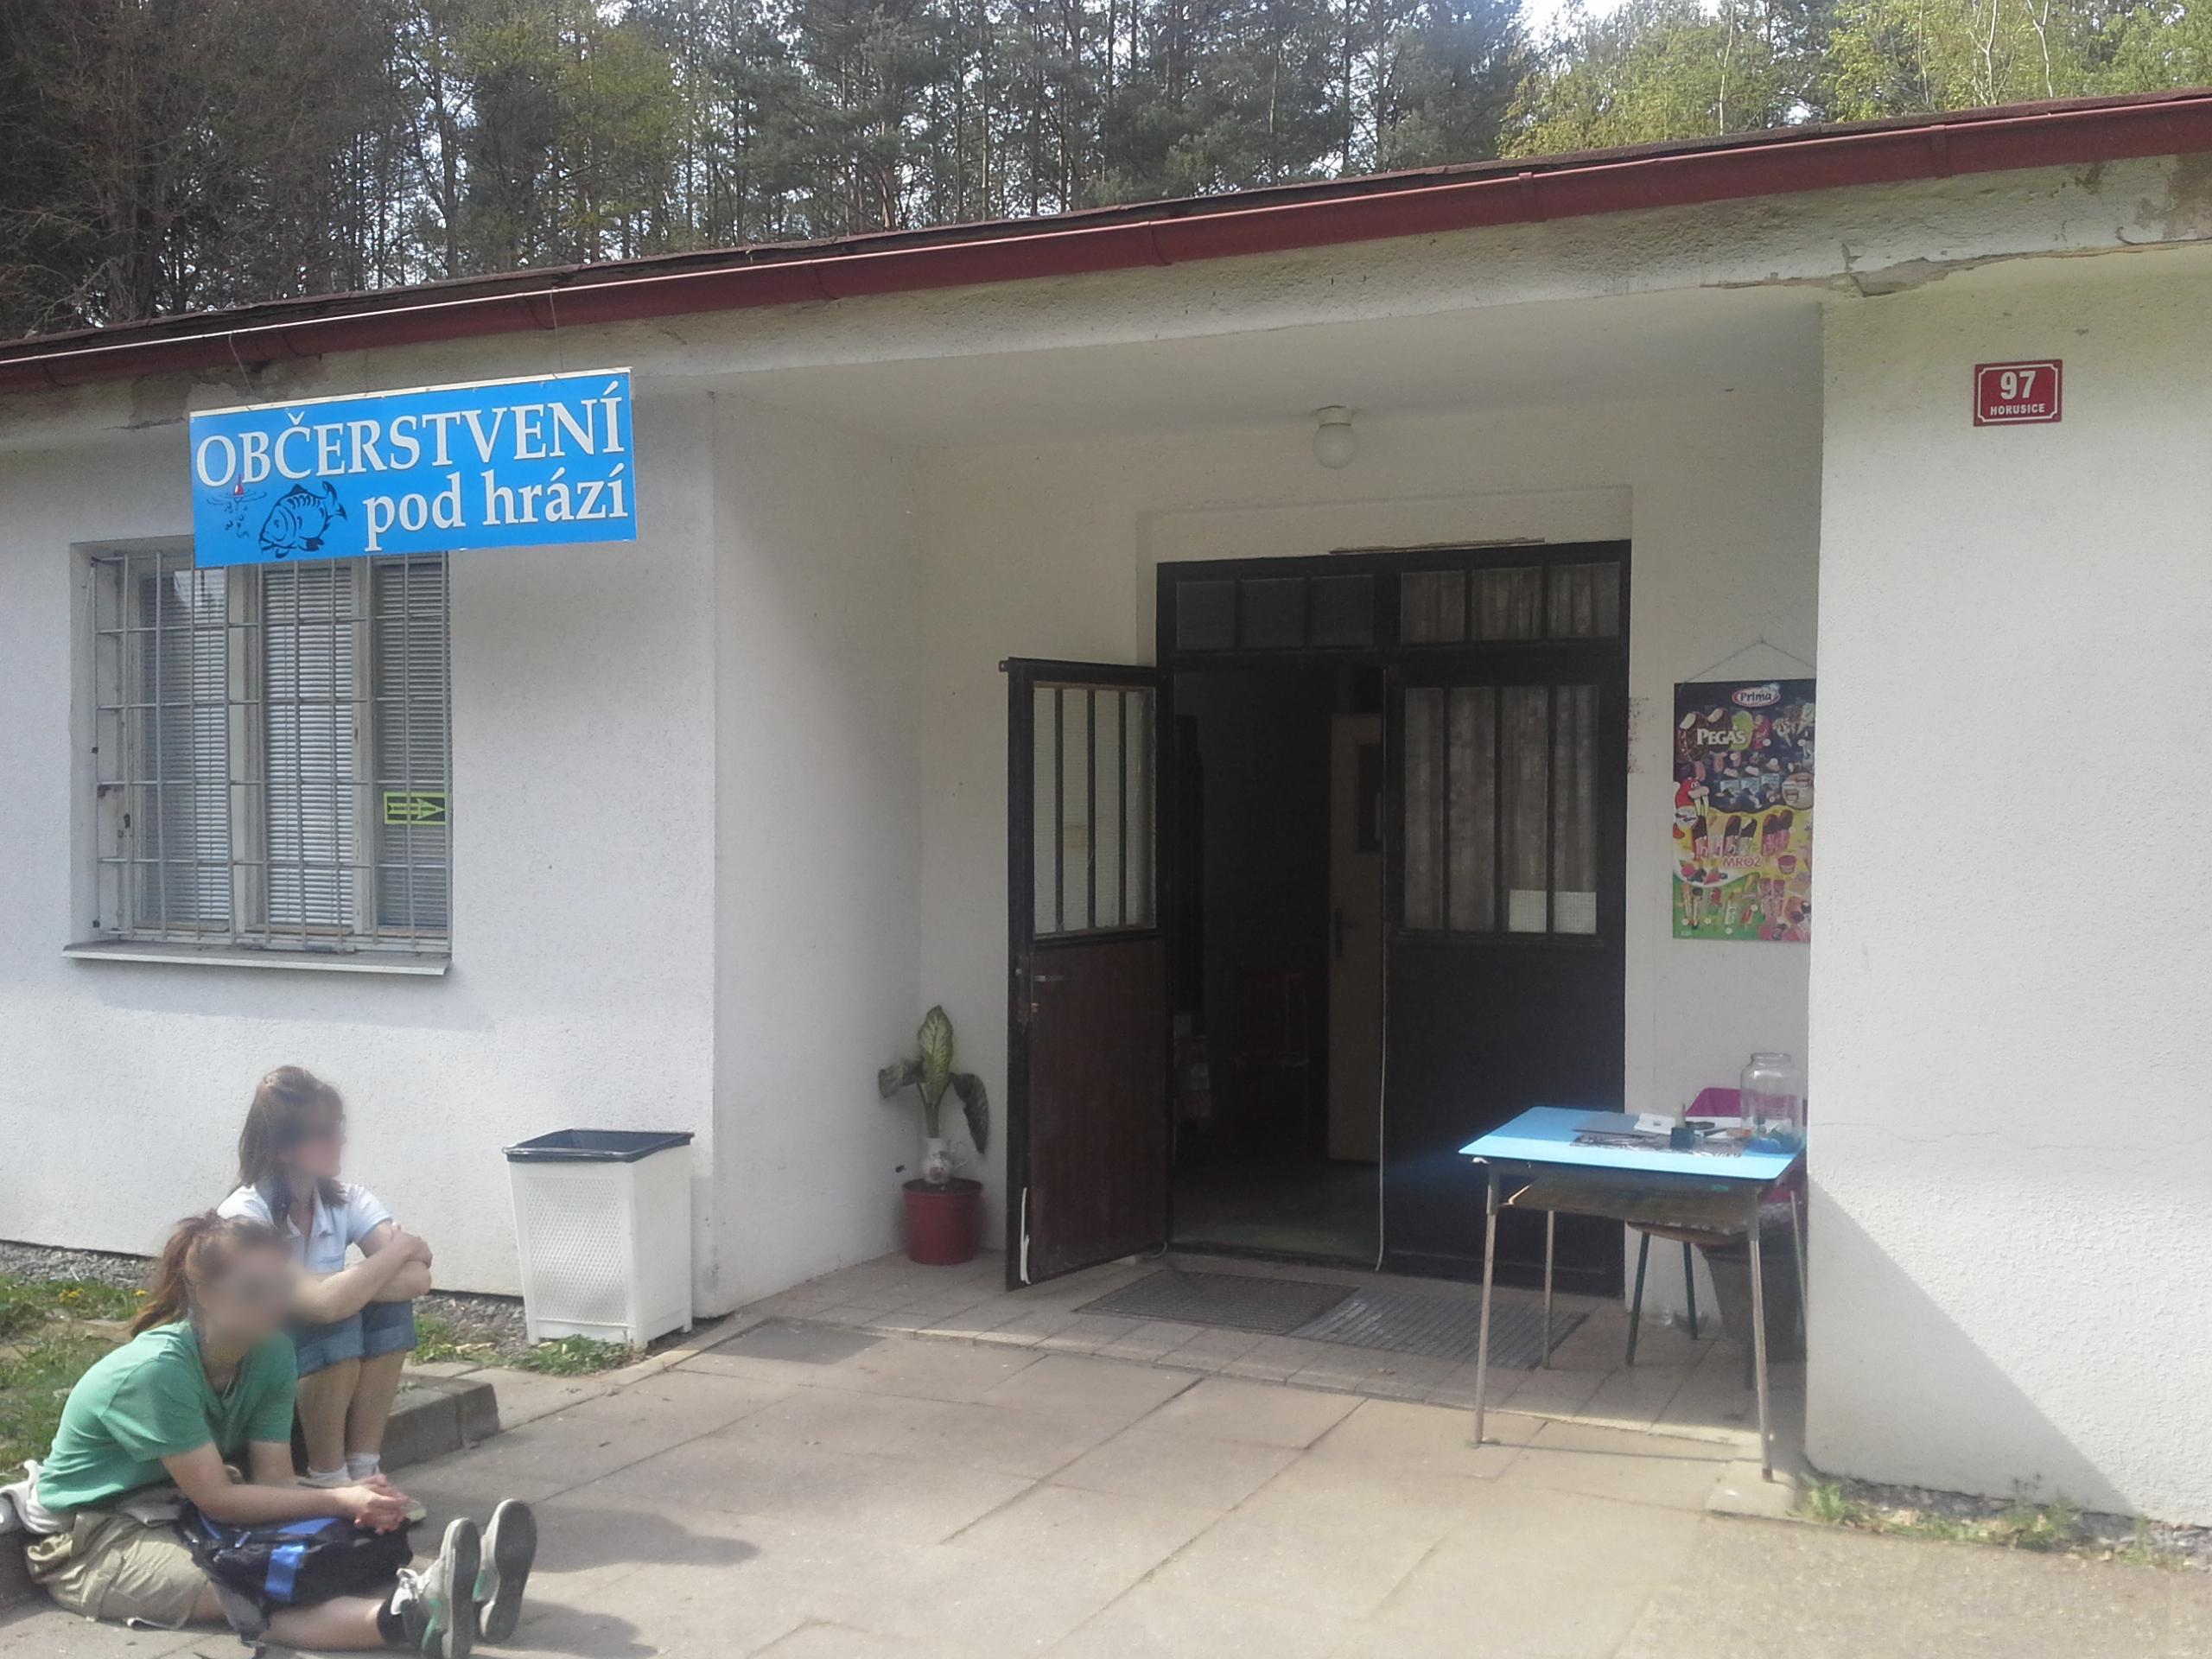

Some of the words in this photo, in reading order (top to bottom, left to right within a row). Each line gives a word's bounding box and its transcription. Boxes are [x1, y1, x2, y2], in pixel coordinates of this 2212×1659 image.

[2000, 371, 2037, 399] 97
[1990, 403, 2045, 416] HORUSICE
[196, 380, 625, 486] OBČERSTVENÍ
[363, 473, 466, 552] pod
[480, 462, 628, 526] hrází
[1740, 691, 1772, 702] Prima
[1696, 728, 1746, 746] PEGAS
